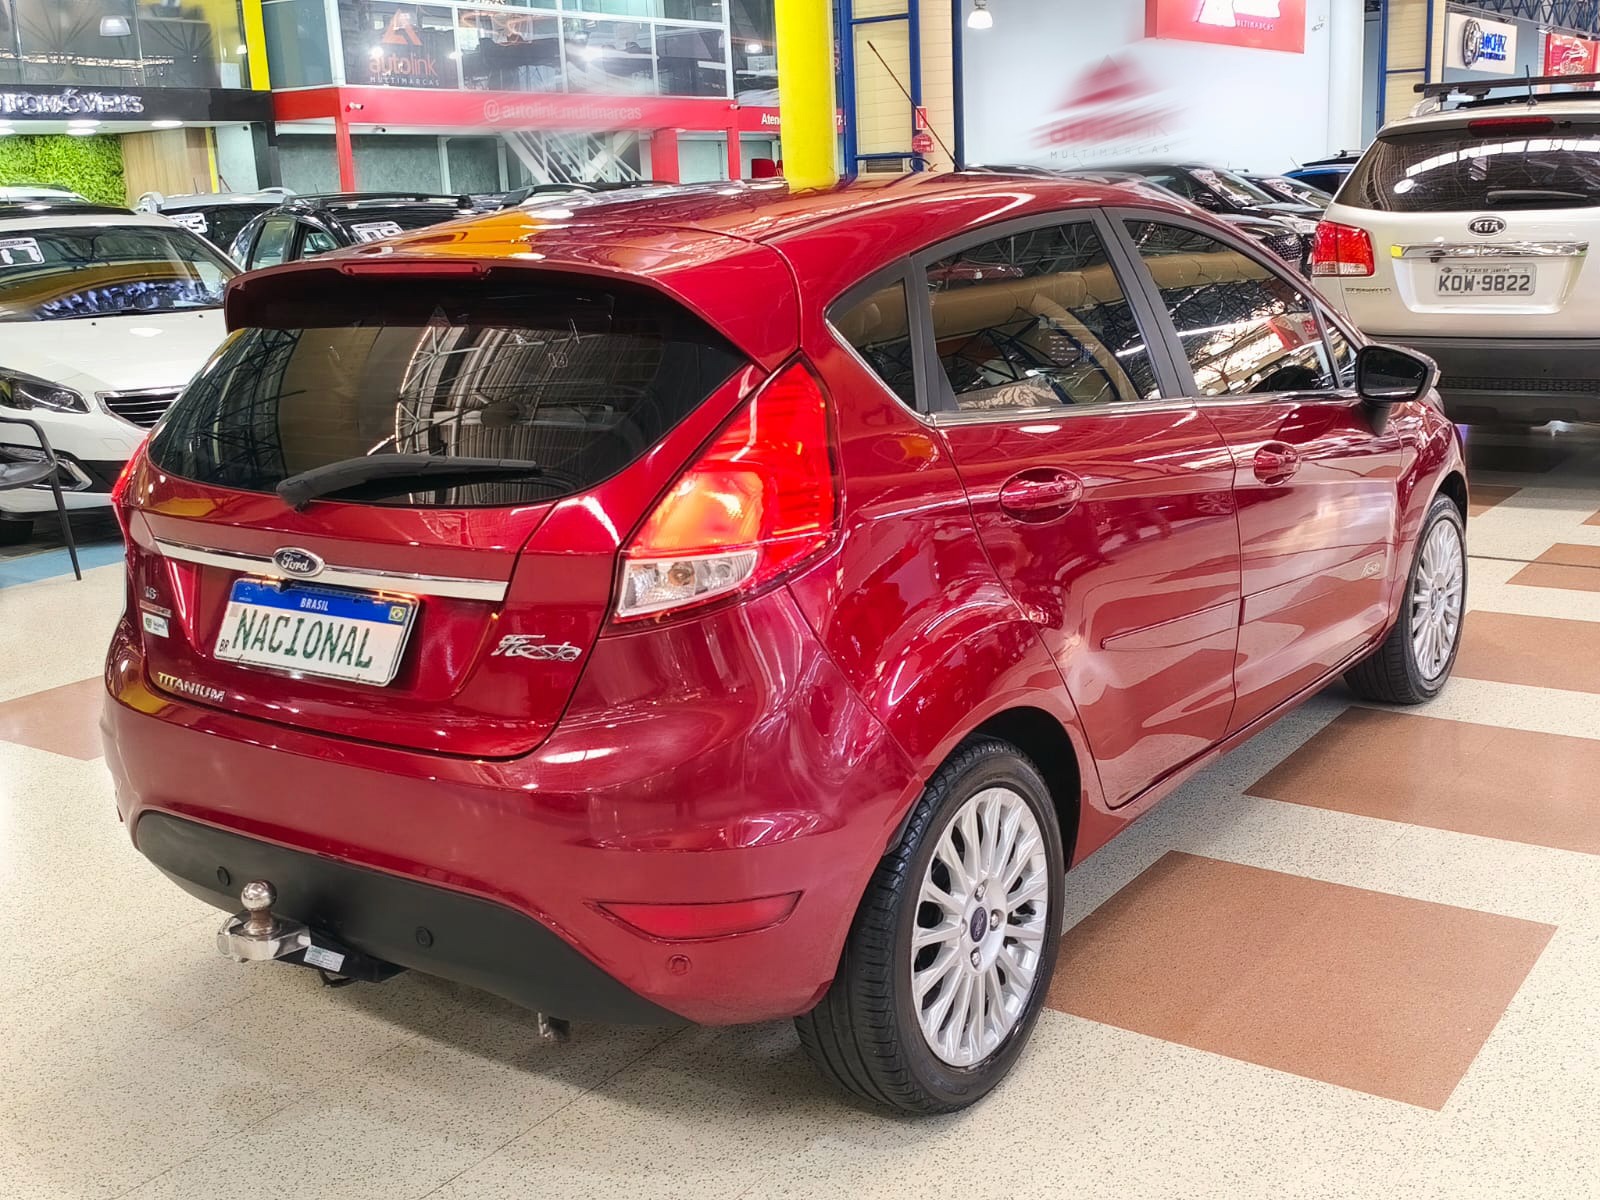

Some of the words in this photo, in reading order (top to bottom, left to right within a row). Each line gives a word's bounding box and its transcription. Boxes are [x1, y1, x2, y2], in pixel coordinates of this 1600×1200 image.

[368, 52, 439, 77] autolink
[0, 89, 145, 115] TOMÓVEIS
[761, 112, 780, 126] Aten
[1473, 220, 1499, 231] KIA
[280, 552, 310, 572] Ford
[299, 597, 329, 612] BRASIL
[218, 638, 230, 653] BR
[231, 607, 374, 669] NACIONAL
[490, 634, 583, 663] Fiesta
[158, 671, 225, 703] TITANIUM
